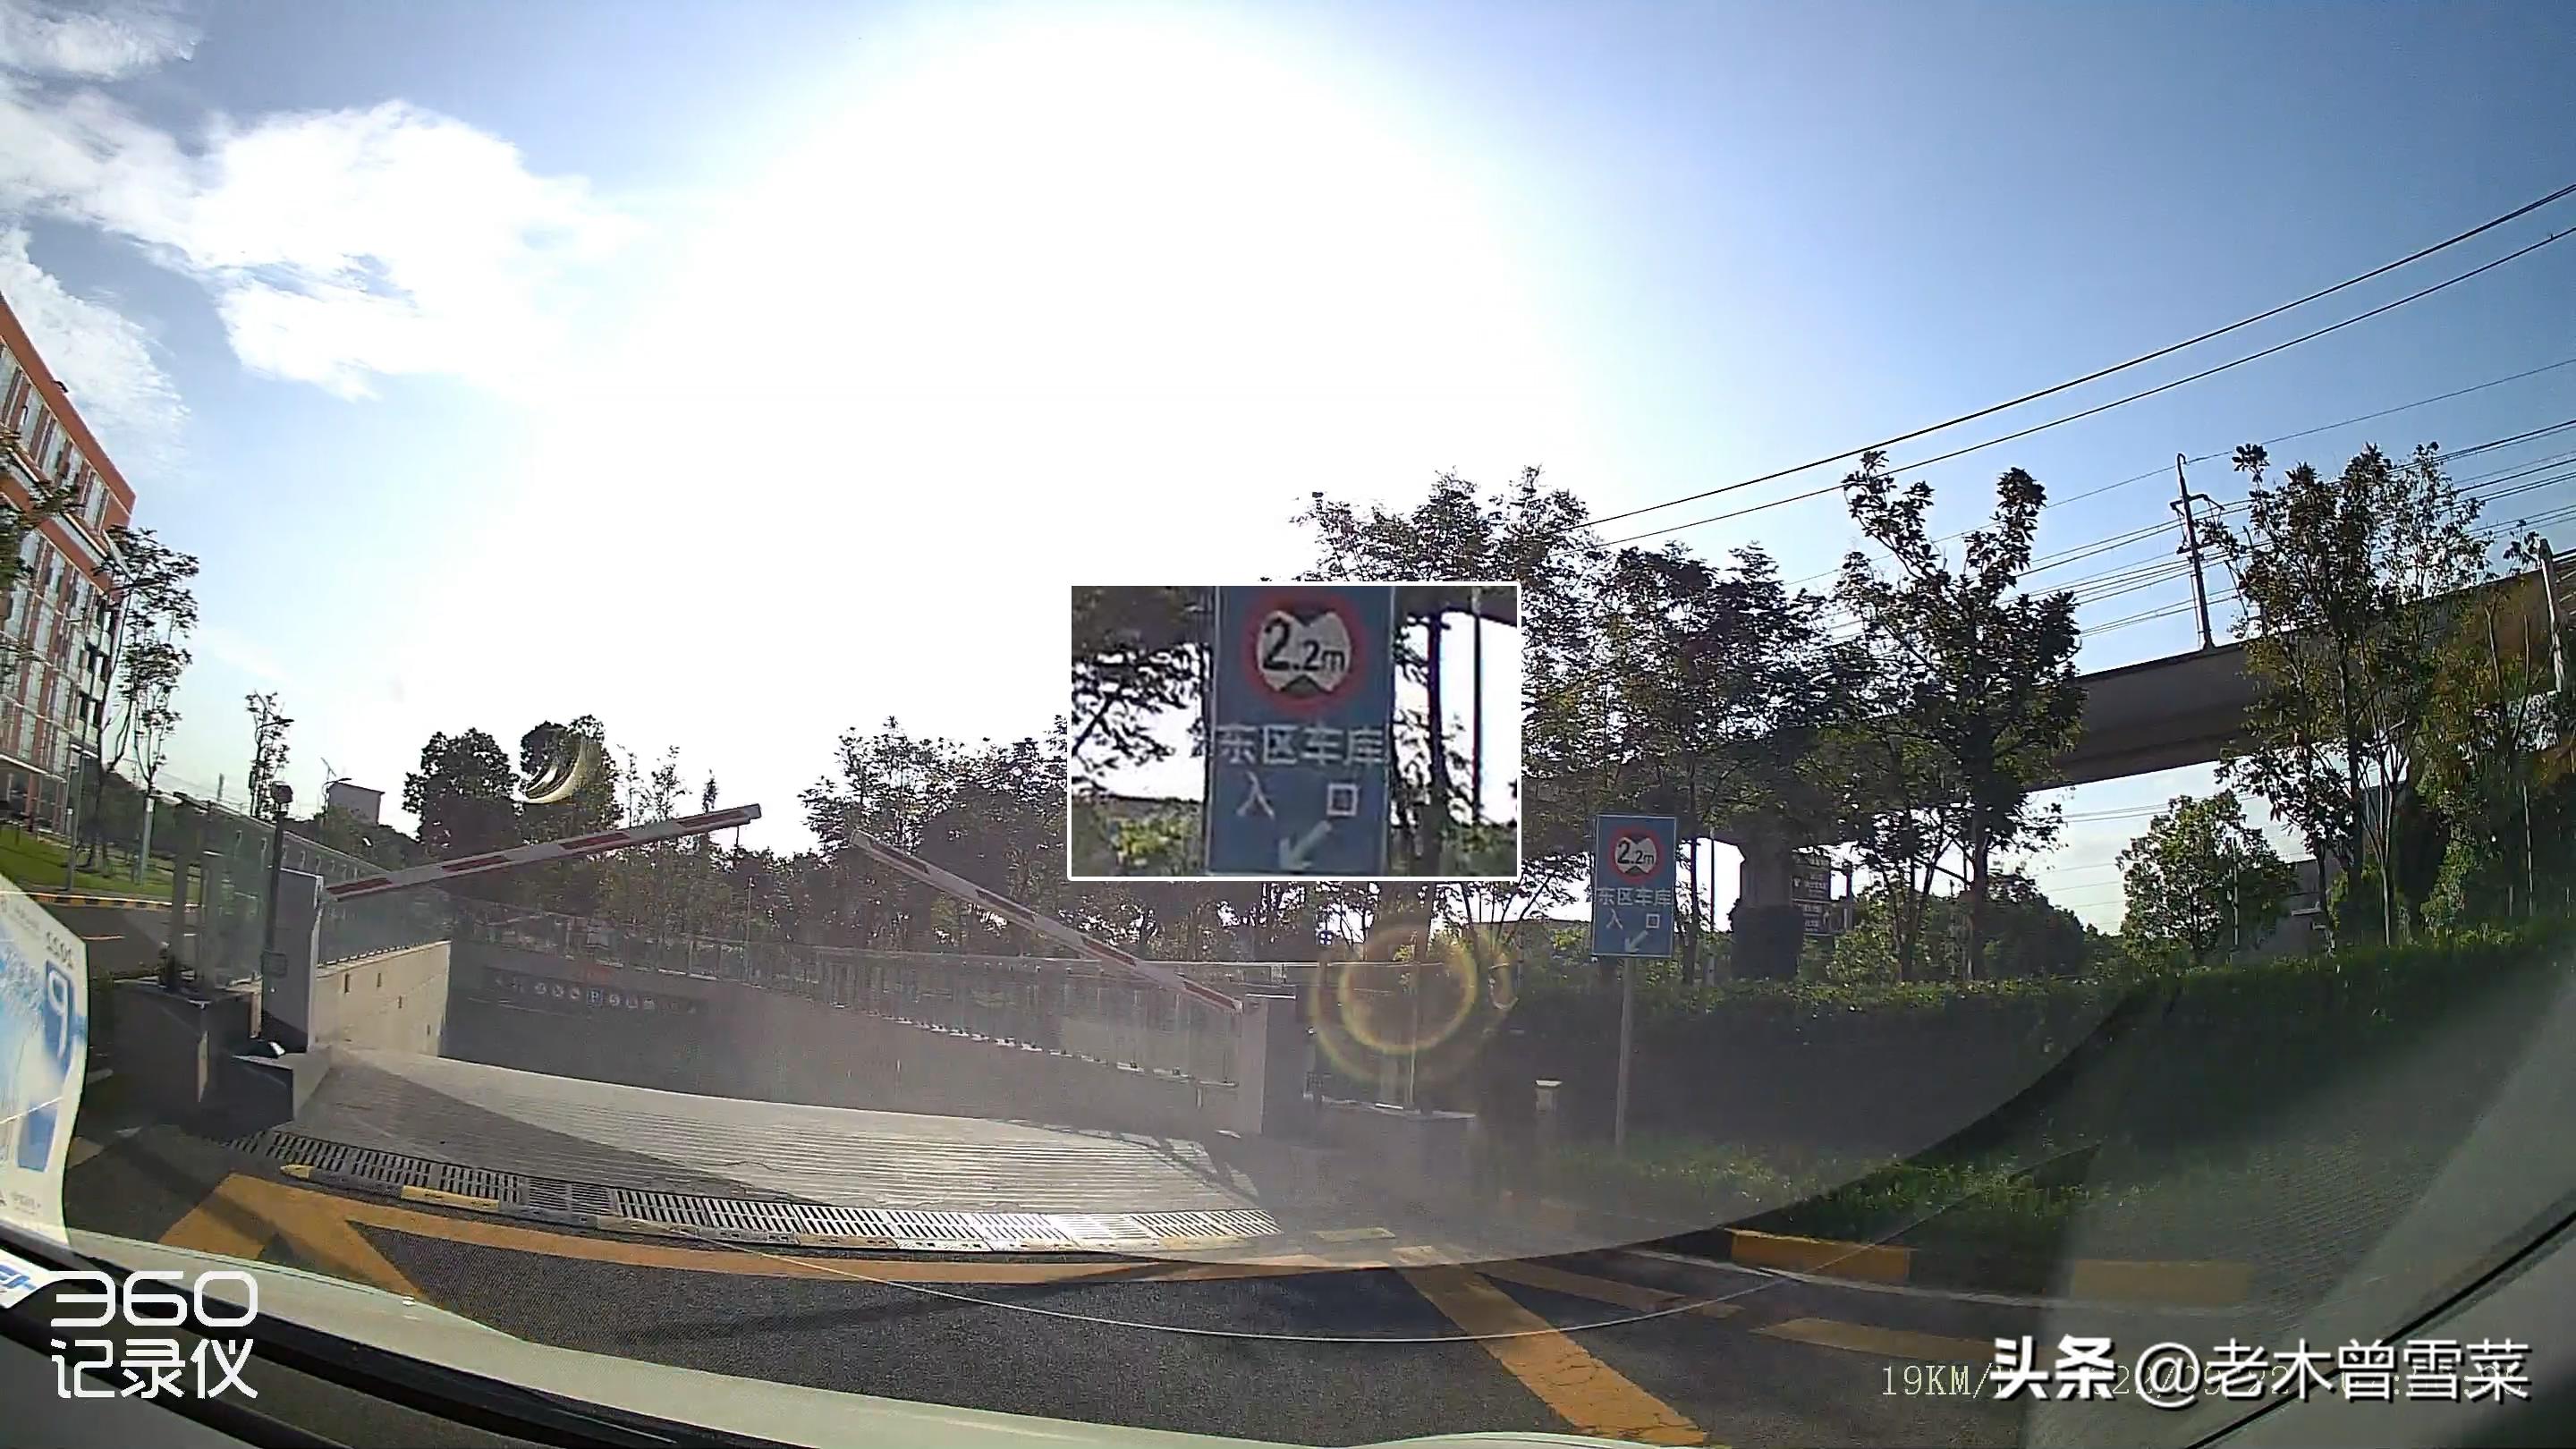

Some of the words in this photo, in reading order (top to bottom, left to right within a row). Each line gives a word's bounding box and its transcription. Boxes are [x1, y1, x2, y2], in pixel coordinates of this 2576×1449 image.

[1262, 616, 1345, 674] 2.2m
[1217, 723, 1385, 767] 东区车库
[1617, 839, 1655, 865] 2.2m
[1597, 886, 1673, 906] 东区车库
